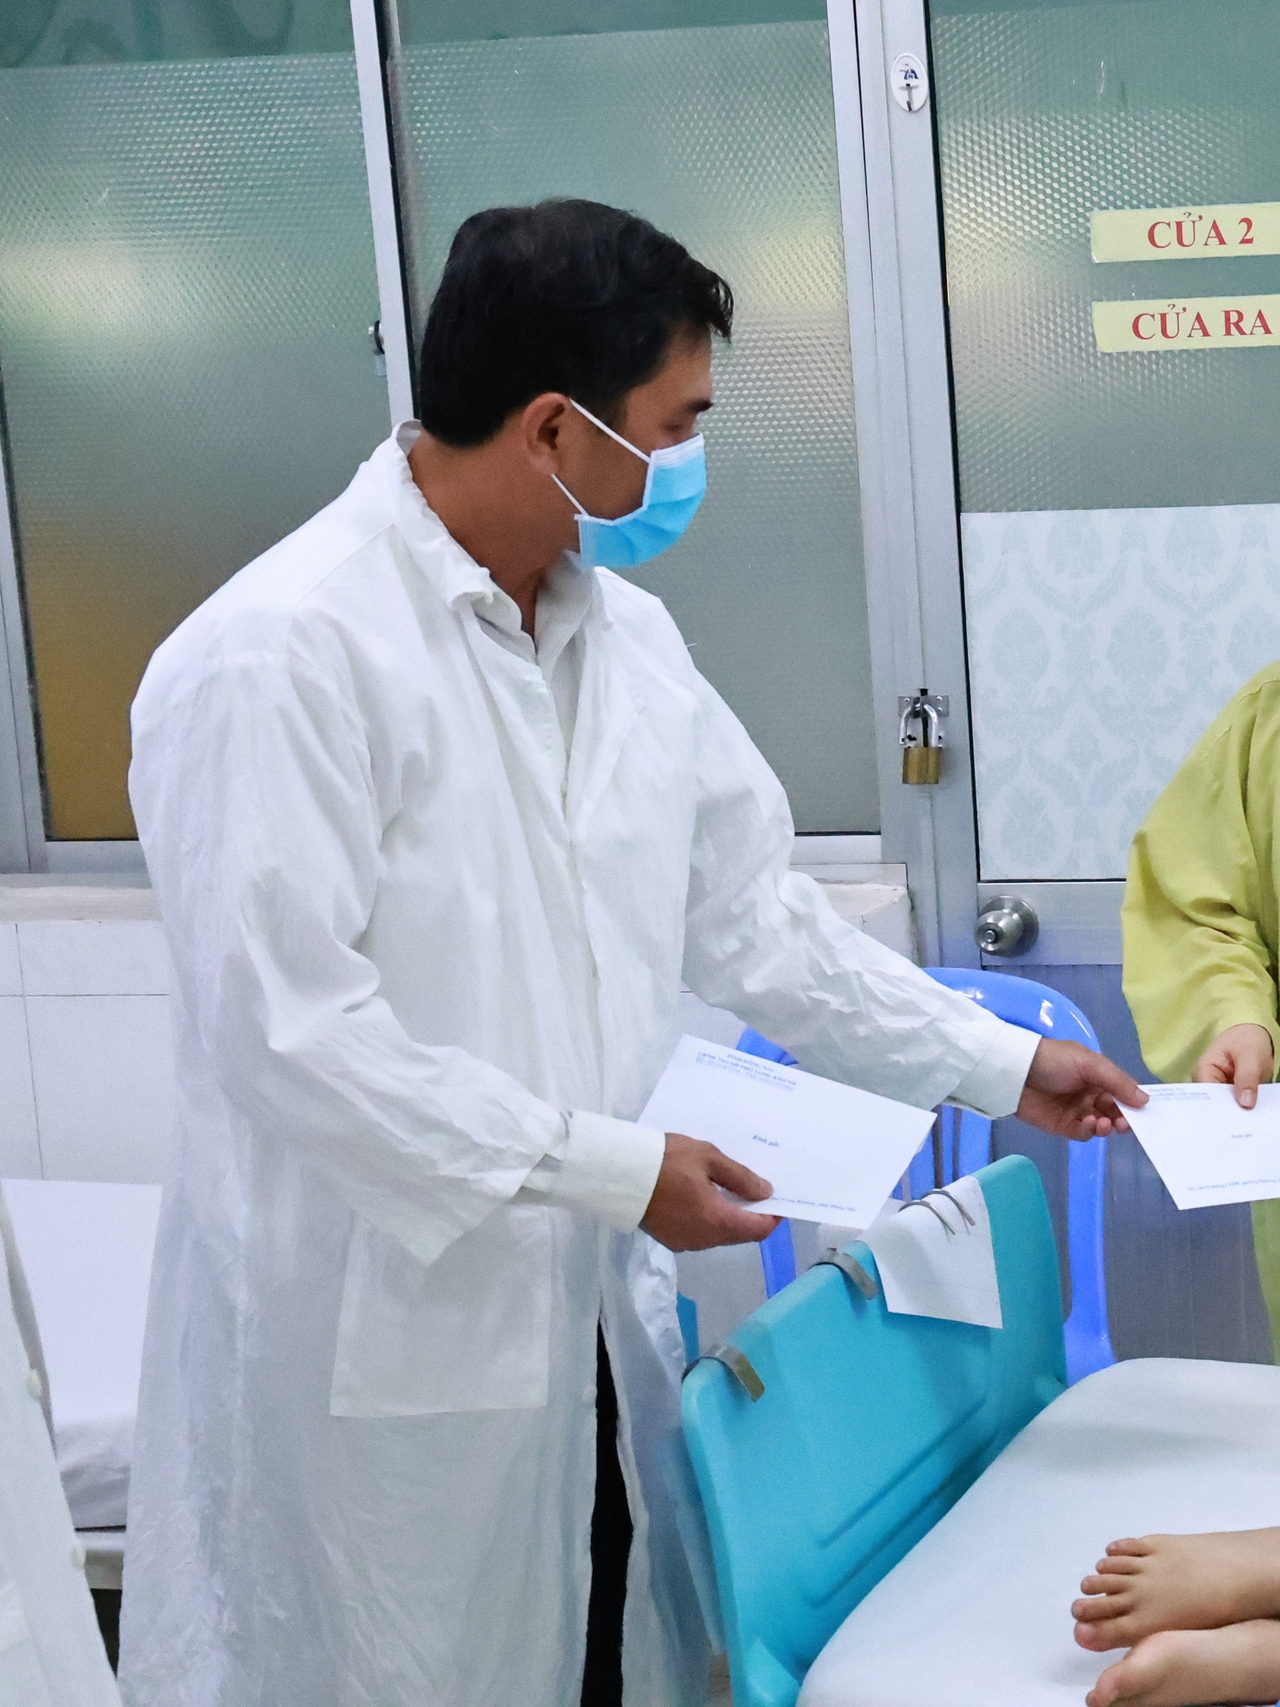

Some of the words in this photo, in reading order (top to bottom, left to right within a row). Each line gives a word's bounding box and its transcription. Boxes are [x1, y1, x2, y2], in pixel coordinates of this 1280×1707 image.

[1147, 211, 1228, 249] CỬA
[1238, 217, 1255, 245] 2
[1131, 303, 1211, 340] CỬA
[1222, 308, 1273, 336] RA
